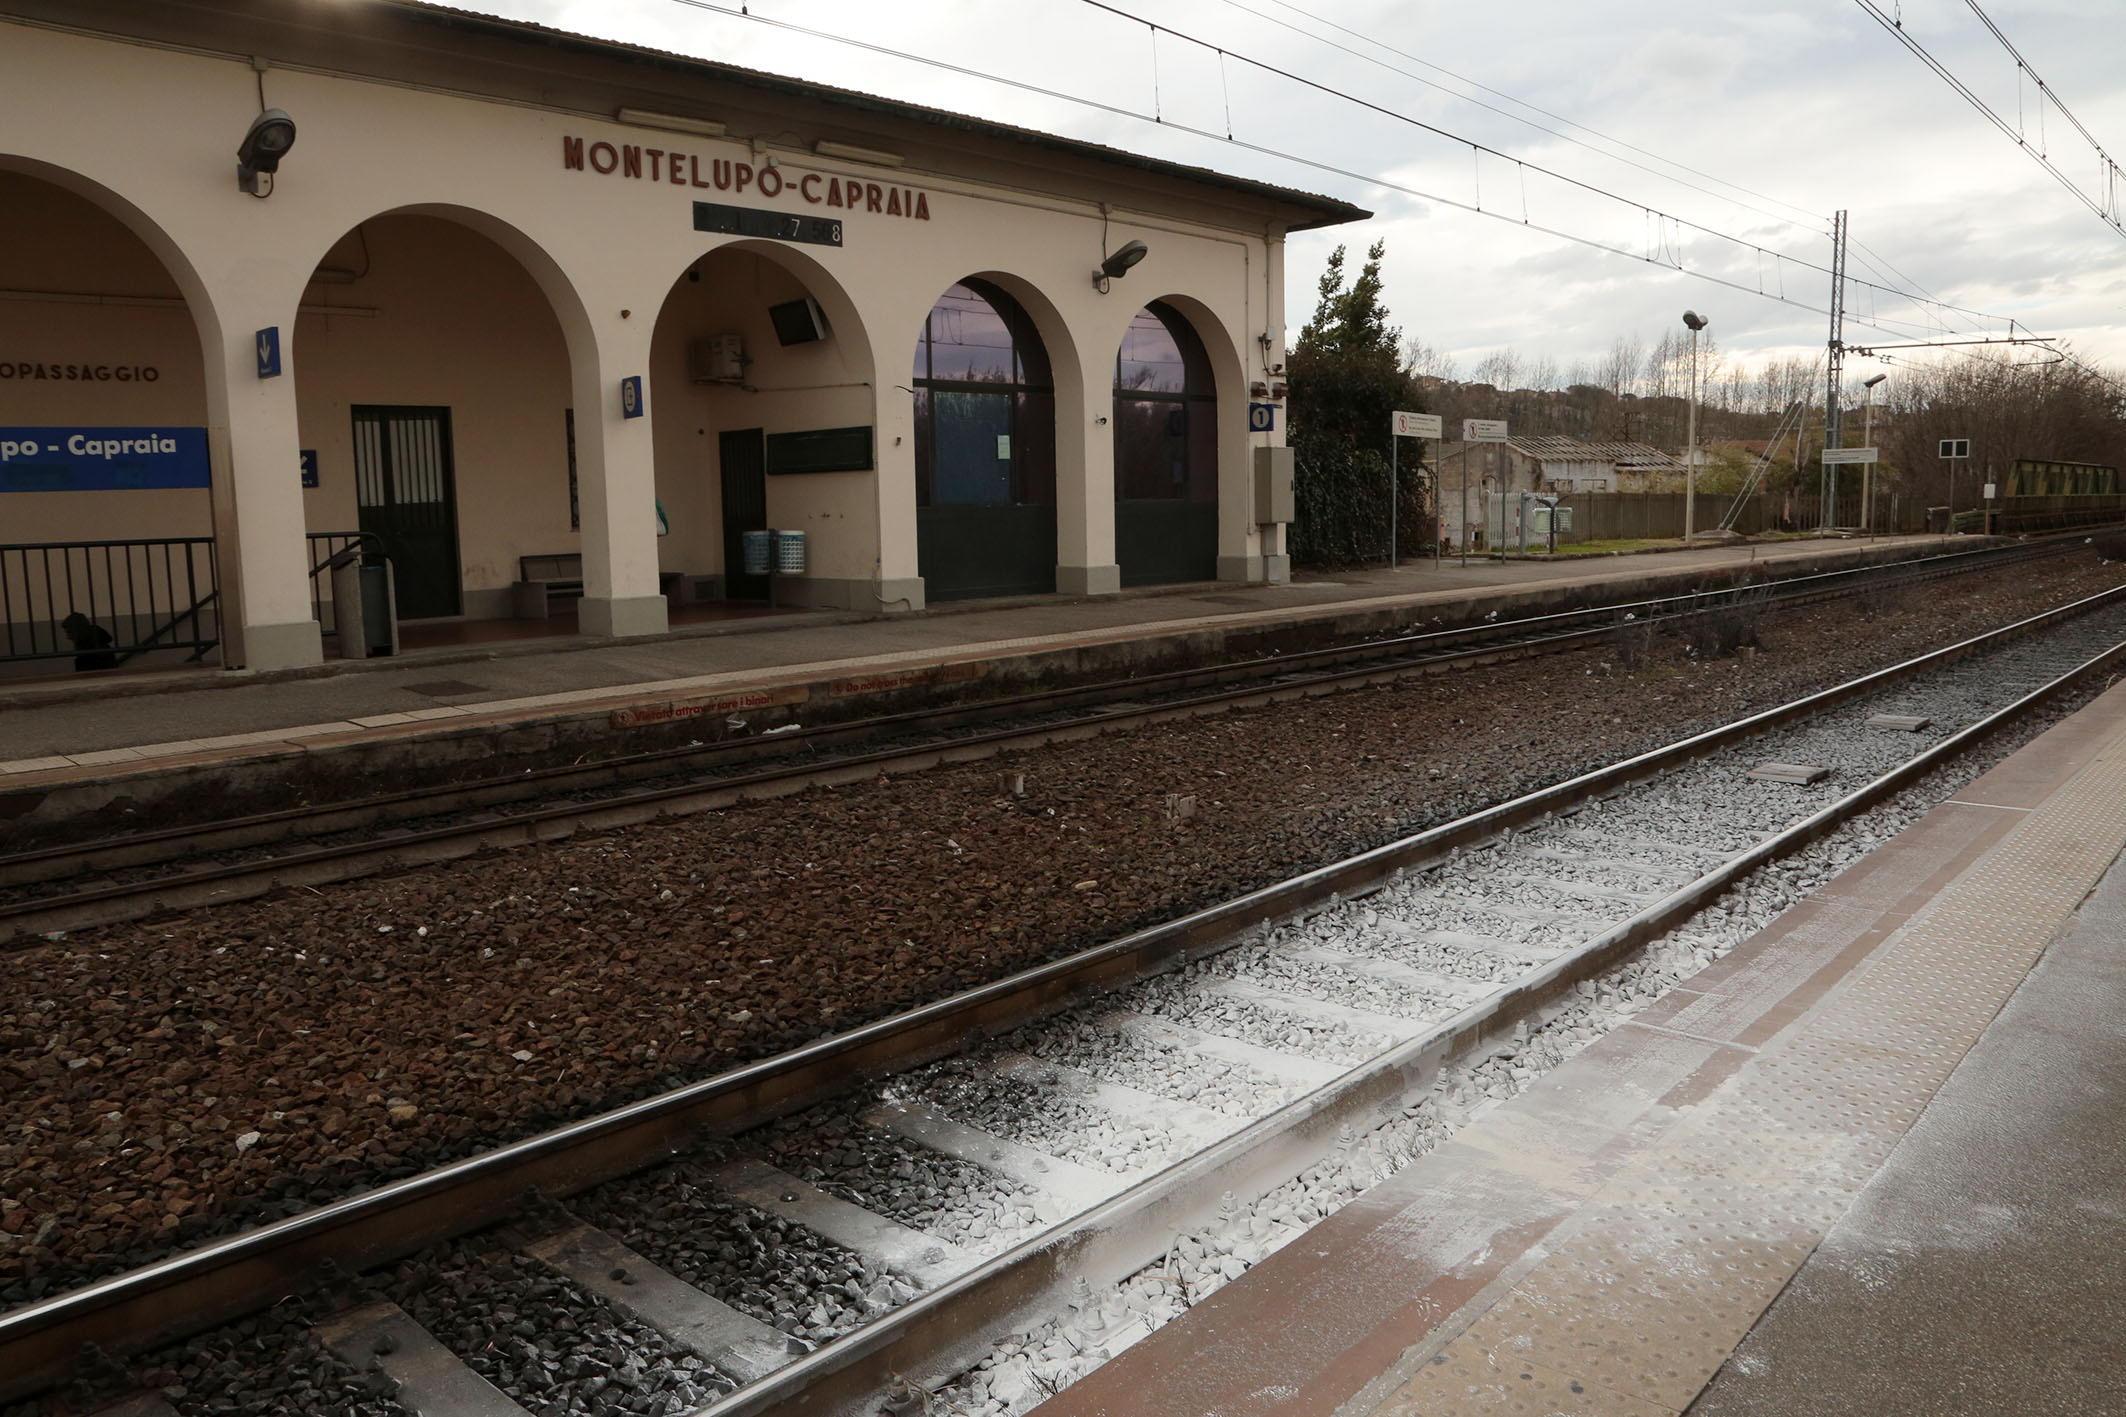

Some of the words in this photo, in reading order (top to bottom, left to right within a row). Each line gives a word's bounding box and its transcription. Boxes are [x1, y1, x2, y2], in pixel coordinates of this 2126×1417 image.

[564, 135, 930, 220] MONTELUPO-CAPRAIA
[0, 362, 159, 382] OPASSAGGIO
[1258, 411, 1264, 425] 1
[1, 440, 39, 461] po
[67, 433, 177, 460] Capraia
[846, 682, 859, 692] Do
[676, 700, 738, 717] attravrsare
